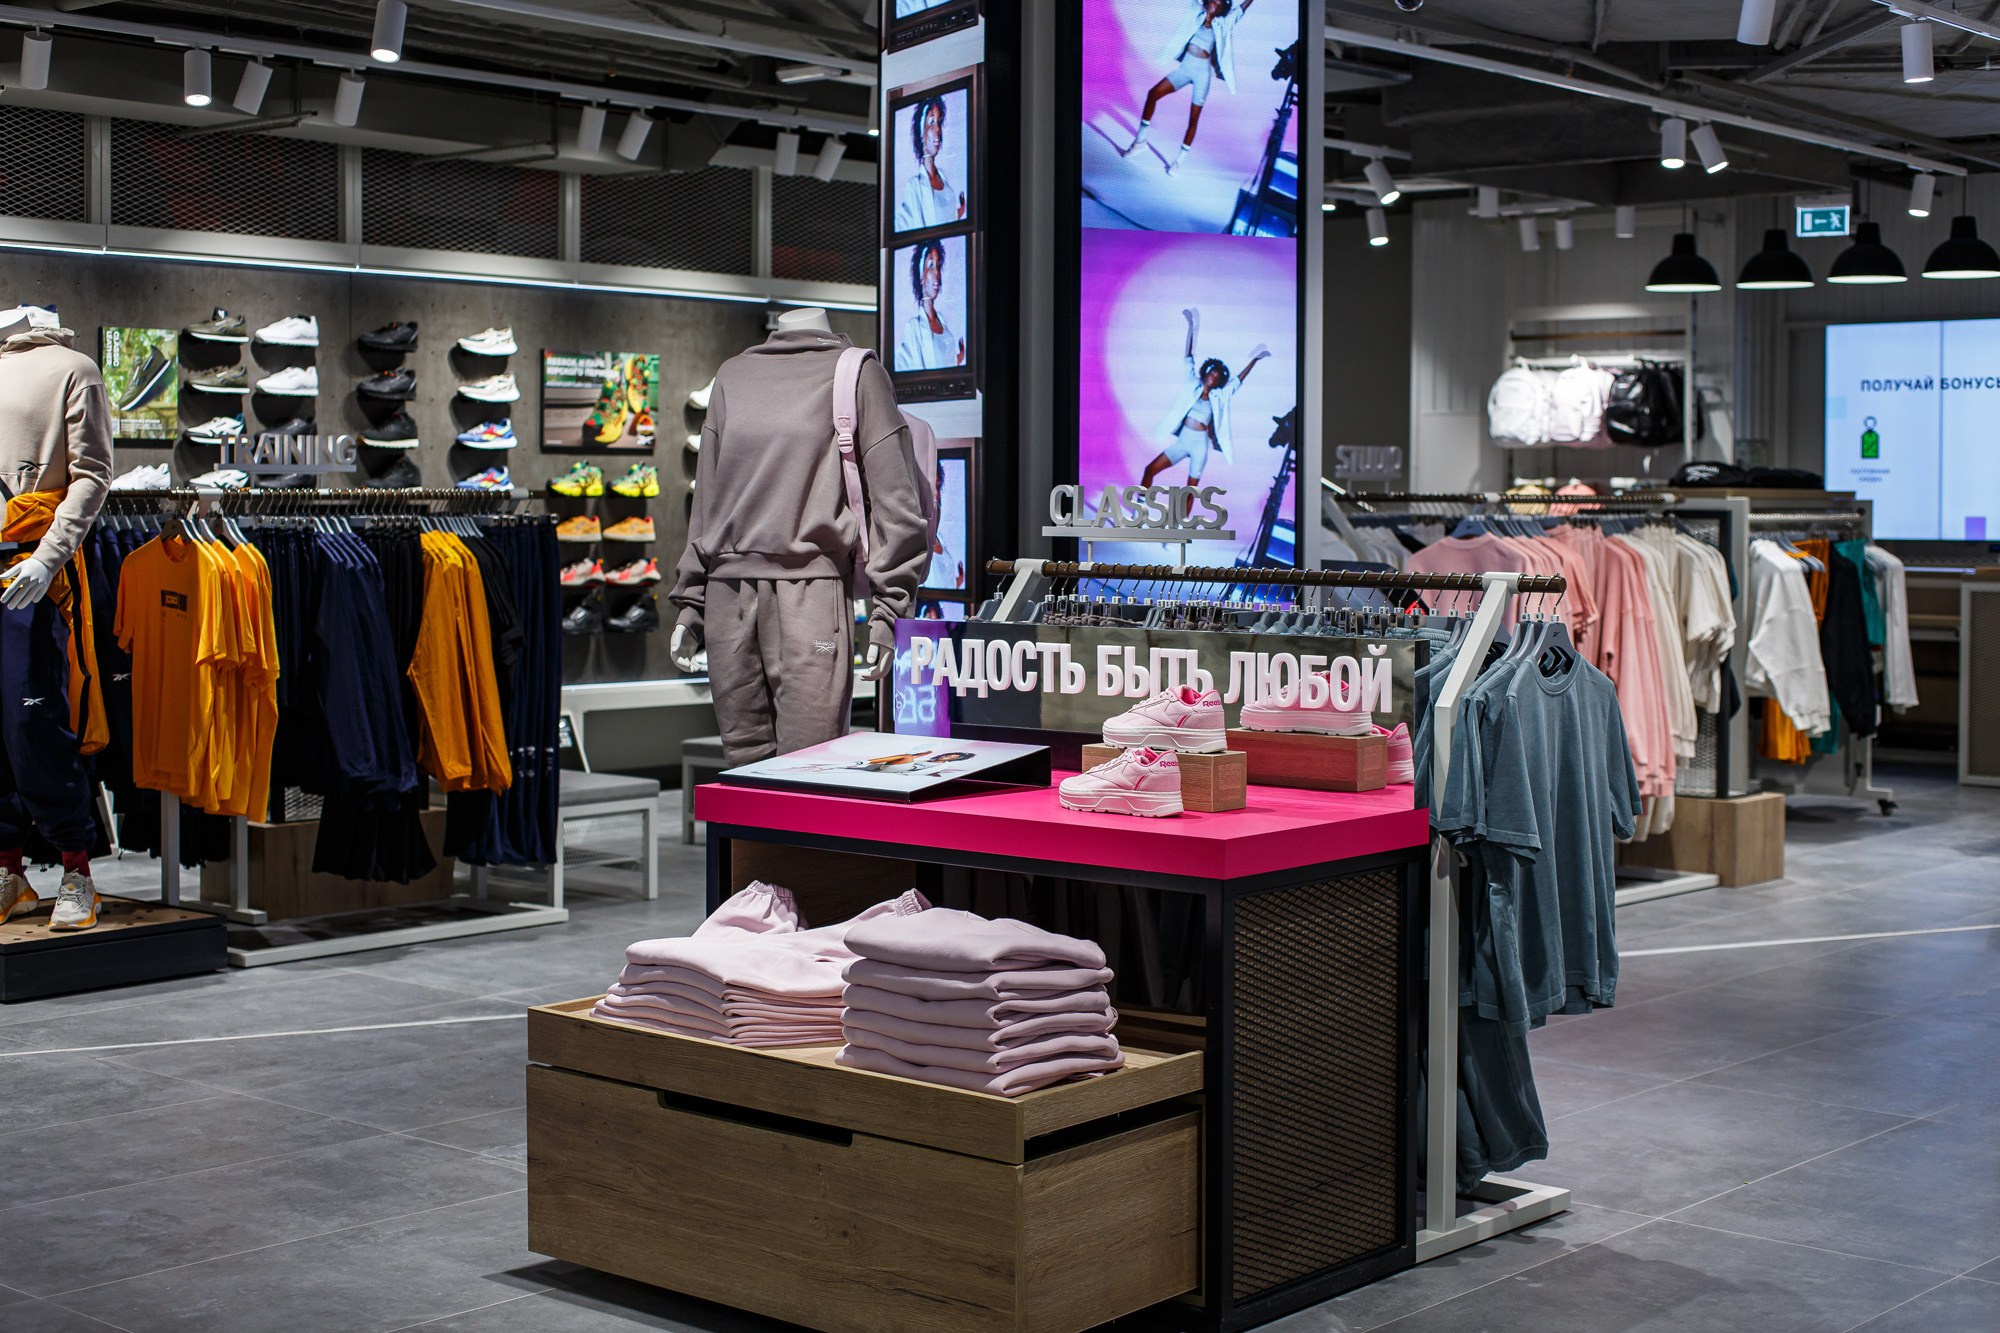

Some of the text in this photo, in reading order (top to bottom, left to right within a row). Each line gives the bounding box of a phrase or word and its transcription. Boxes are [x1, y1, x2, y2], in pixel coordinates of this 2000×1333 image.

[1860, 376, 1934, 392] ПОЛУЧАЙ
[219, 433, 357, 465] TRAINING
[1050, 484, 1228, 529] CLASSICS
[910, 636, 1393, 713] РАДОСТЬ БЫТЬ ЛЮБОЙ
